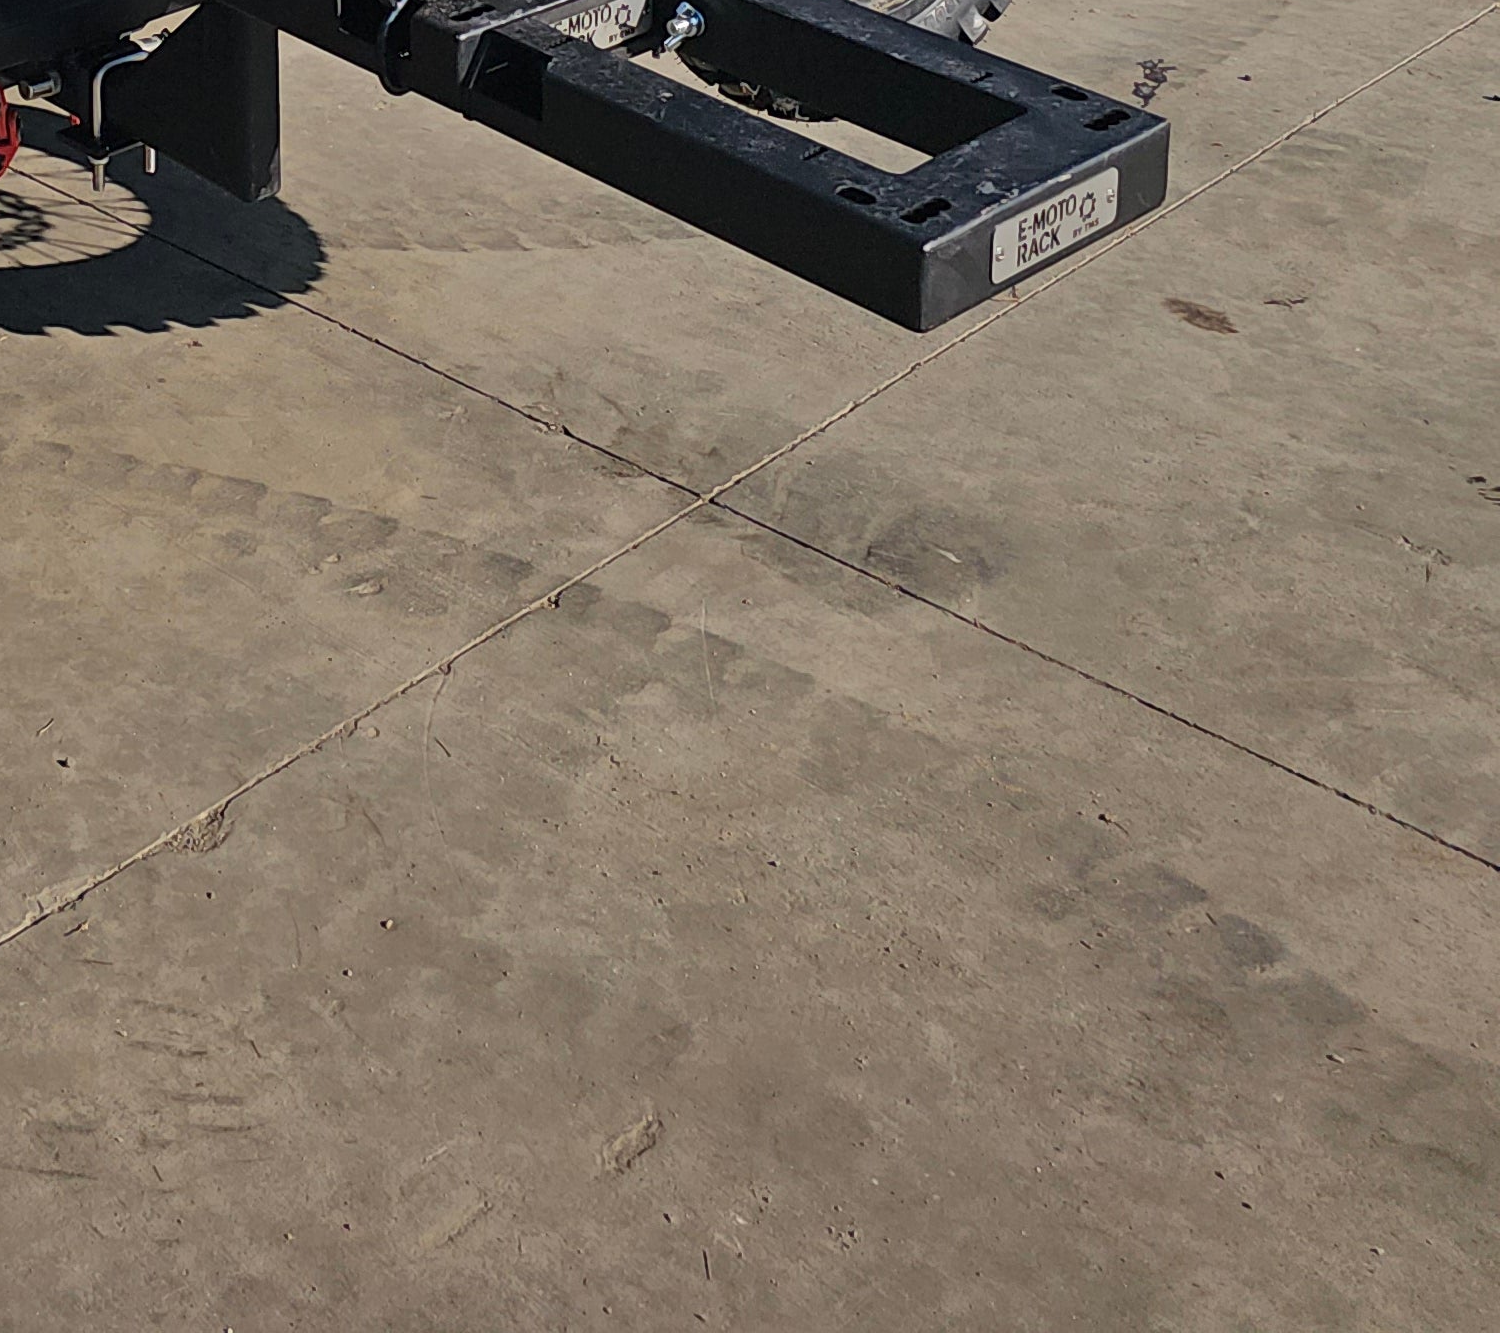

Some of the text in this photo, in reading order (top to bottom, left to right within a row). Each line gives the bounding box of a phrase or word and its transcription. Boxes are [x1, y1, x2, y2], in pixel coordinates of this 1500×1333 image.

[555, 4, 611, 35] -MOTO
[1017, 194, 1077, 242] E-MOTO
[1016, 225, 1062, 267] RACK
